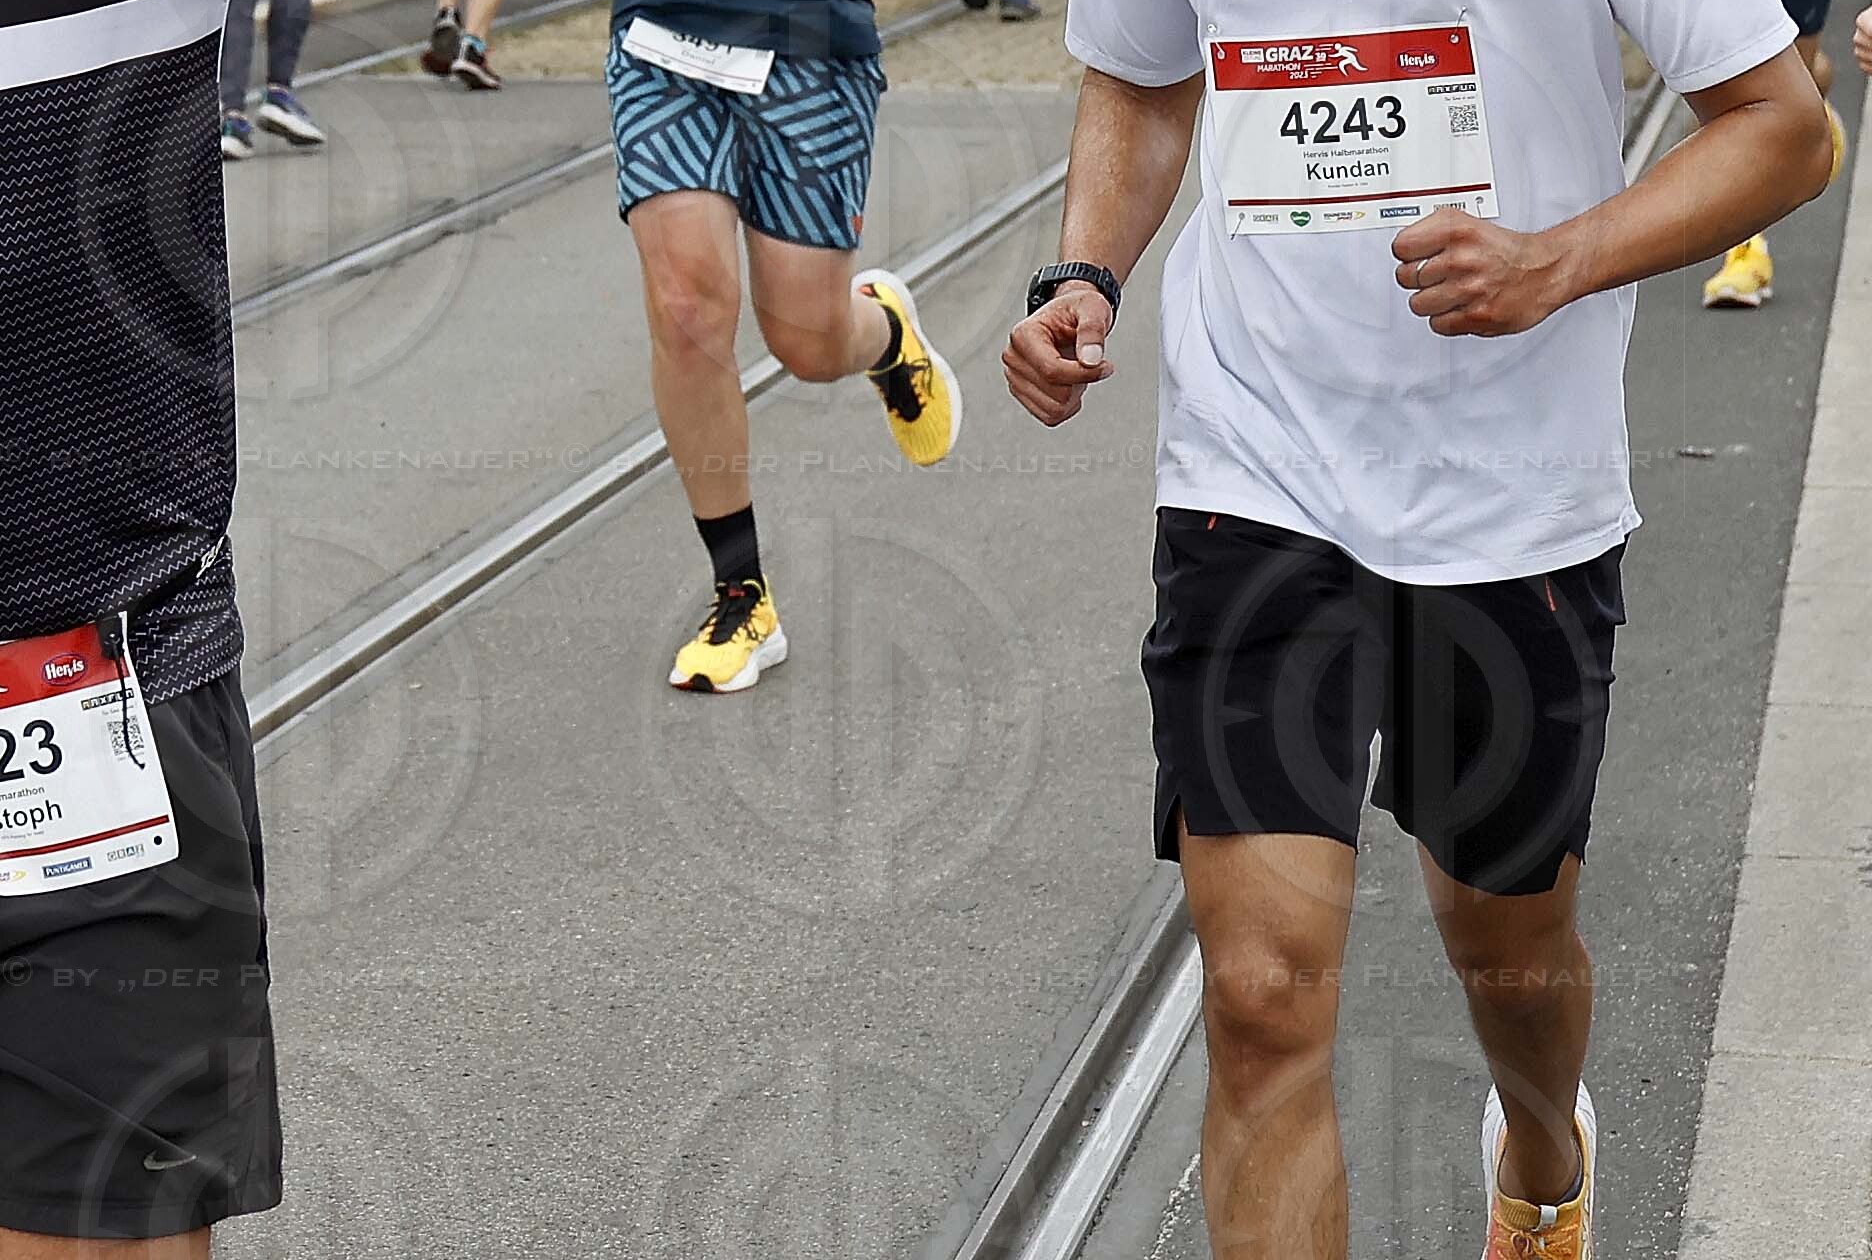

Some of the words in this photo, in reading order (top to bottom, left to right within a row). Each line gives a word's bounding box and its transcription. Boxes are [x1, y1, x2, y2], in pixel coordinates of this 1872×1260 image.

[1265, 44, 1314, 62] GRAZ
[1399, 53, 1435, 67] Hervis
[1256, 62, 1301, 73] MARATHON
[1280, 95, 1407, 145] 4243
[1303, 150, 1329, 159] Hervis
[1330, 146, 1389, 157] Halbmarathon
[1306, 160, 1390, 181] Kundan
[44, 658, 85, 680] Hervis
